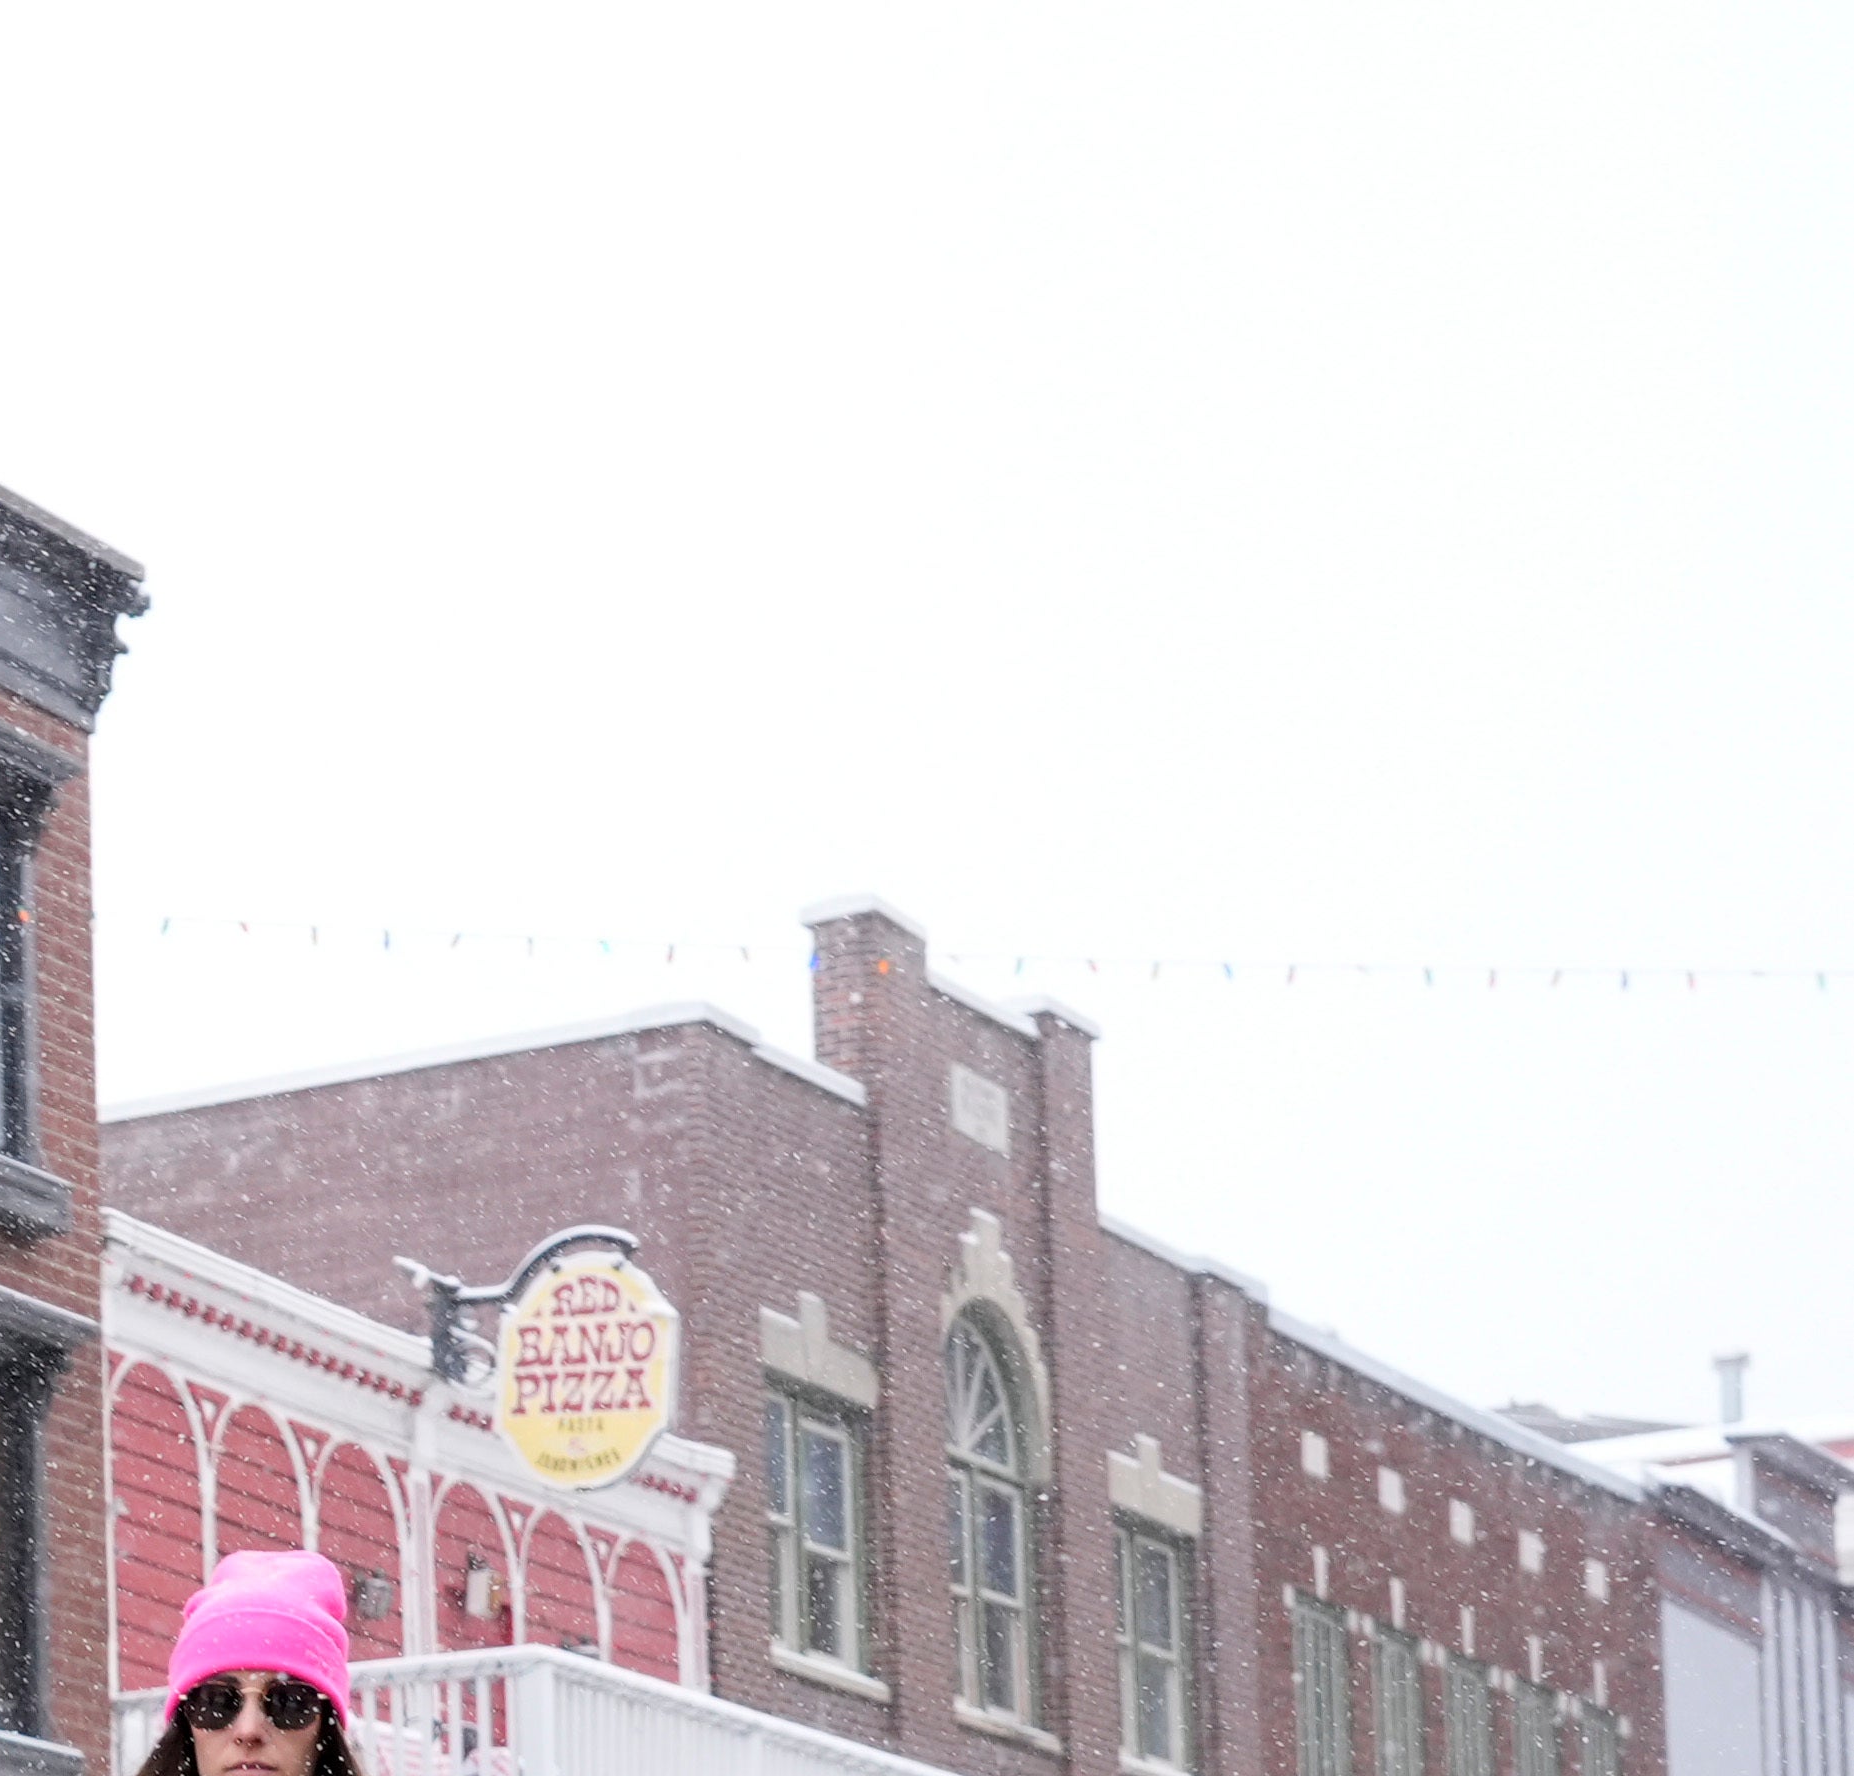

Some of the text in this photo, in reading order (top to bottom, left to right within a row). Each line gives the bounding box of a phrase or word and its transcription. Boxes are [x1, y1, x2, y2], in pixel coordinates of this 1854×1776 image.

[551, 1276, 620, 1317] RED
[515, 1319, 656, 1368] BANJO
[511, 1368, 652, 1415] PIZZA
